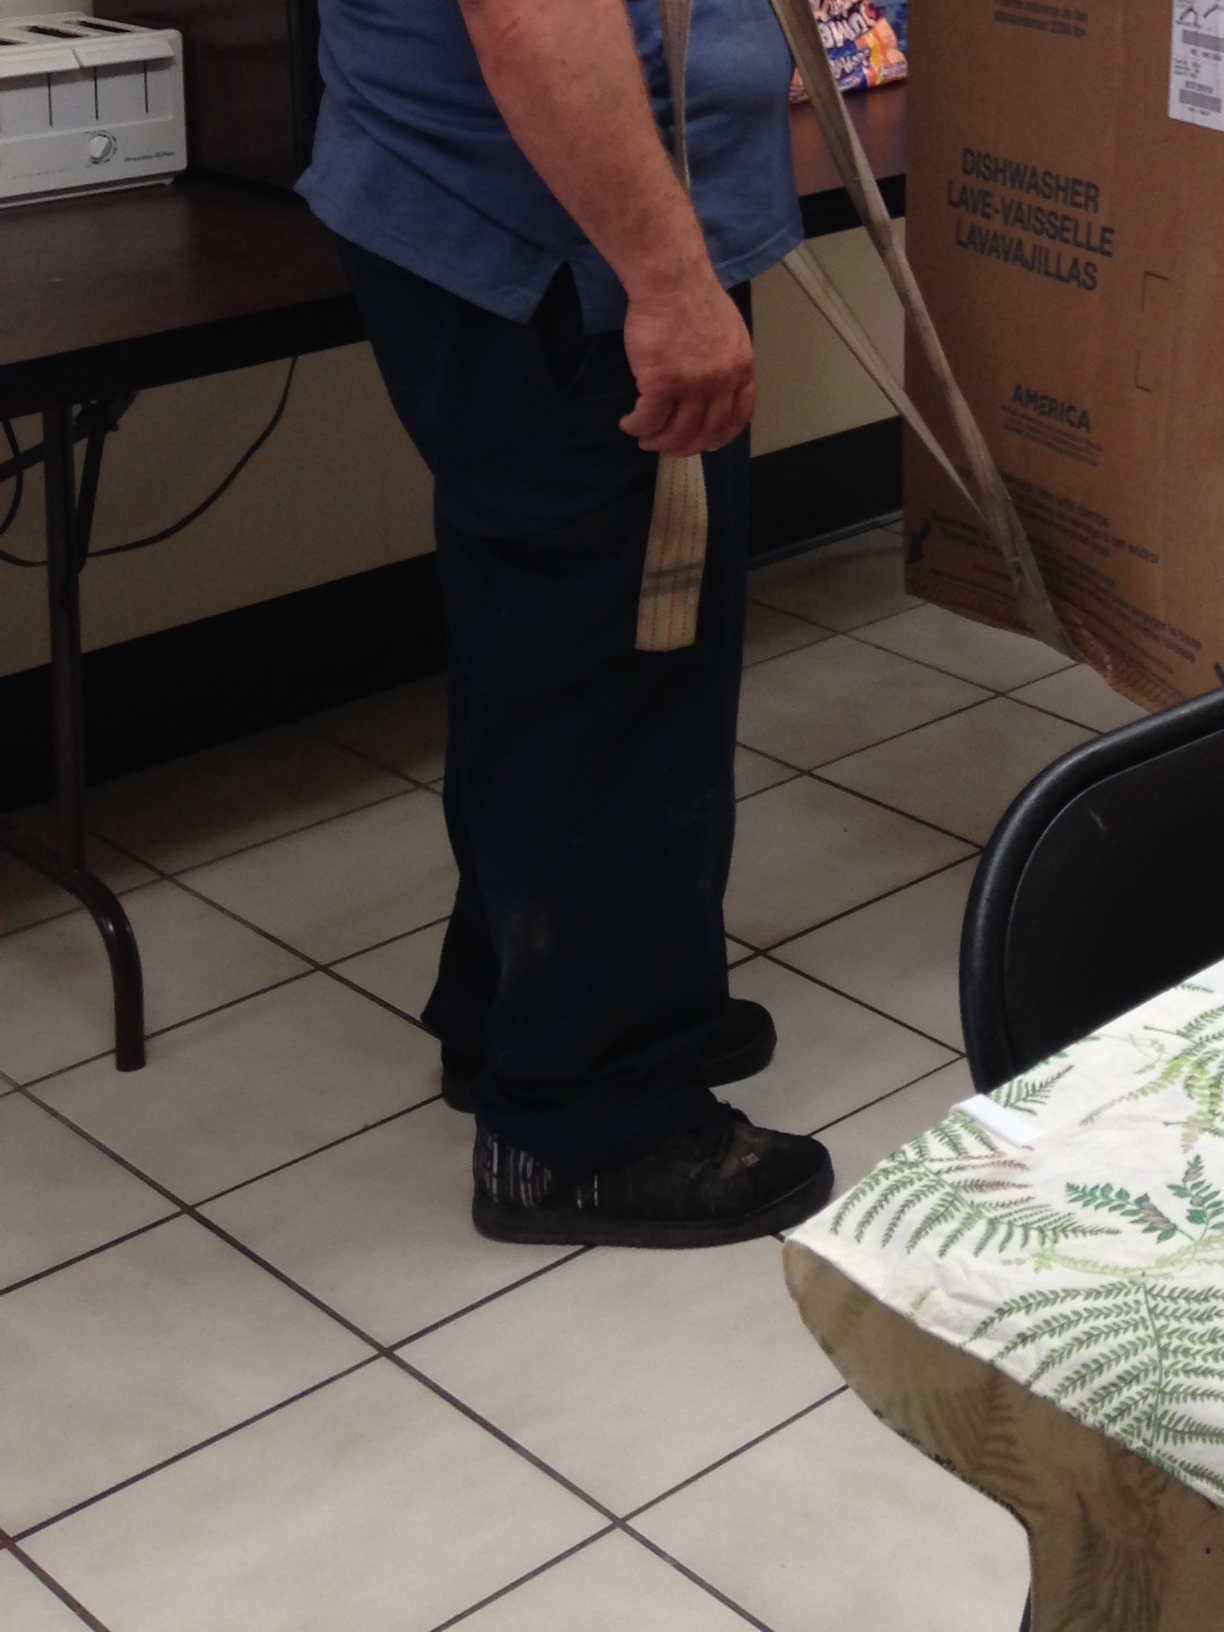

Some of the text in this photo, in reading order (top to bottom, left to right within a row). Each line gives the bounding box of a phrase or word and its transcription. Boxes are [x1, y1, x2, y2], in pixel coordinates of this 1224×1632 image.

[961, 146, 1100, 214] DISHWASHER
[947, 179, 1114, 258] LAVE-VAISSELLE
[955, 217, 1099, 291] LAVAVAJILLAS
[1011, 384, 1091, 433] AMERICA
